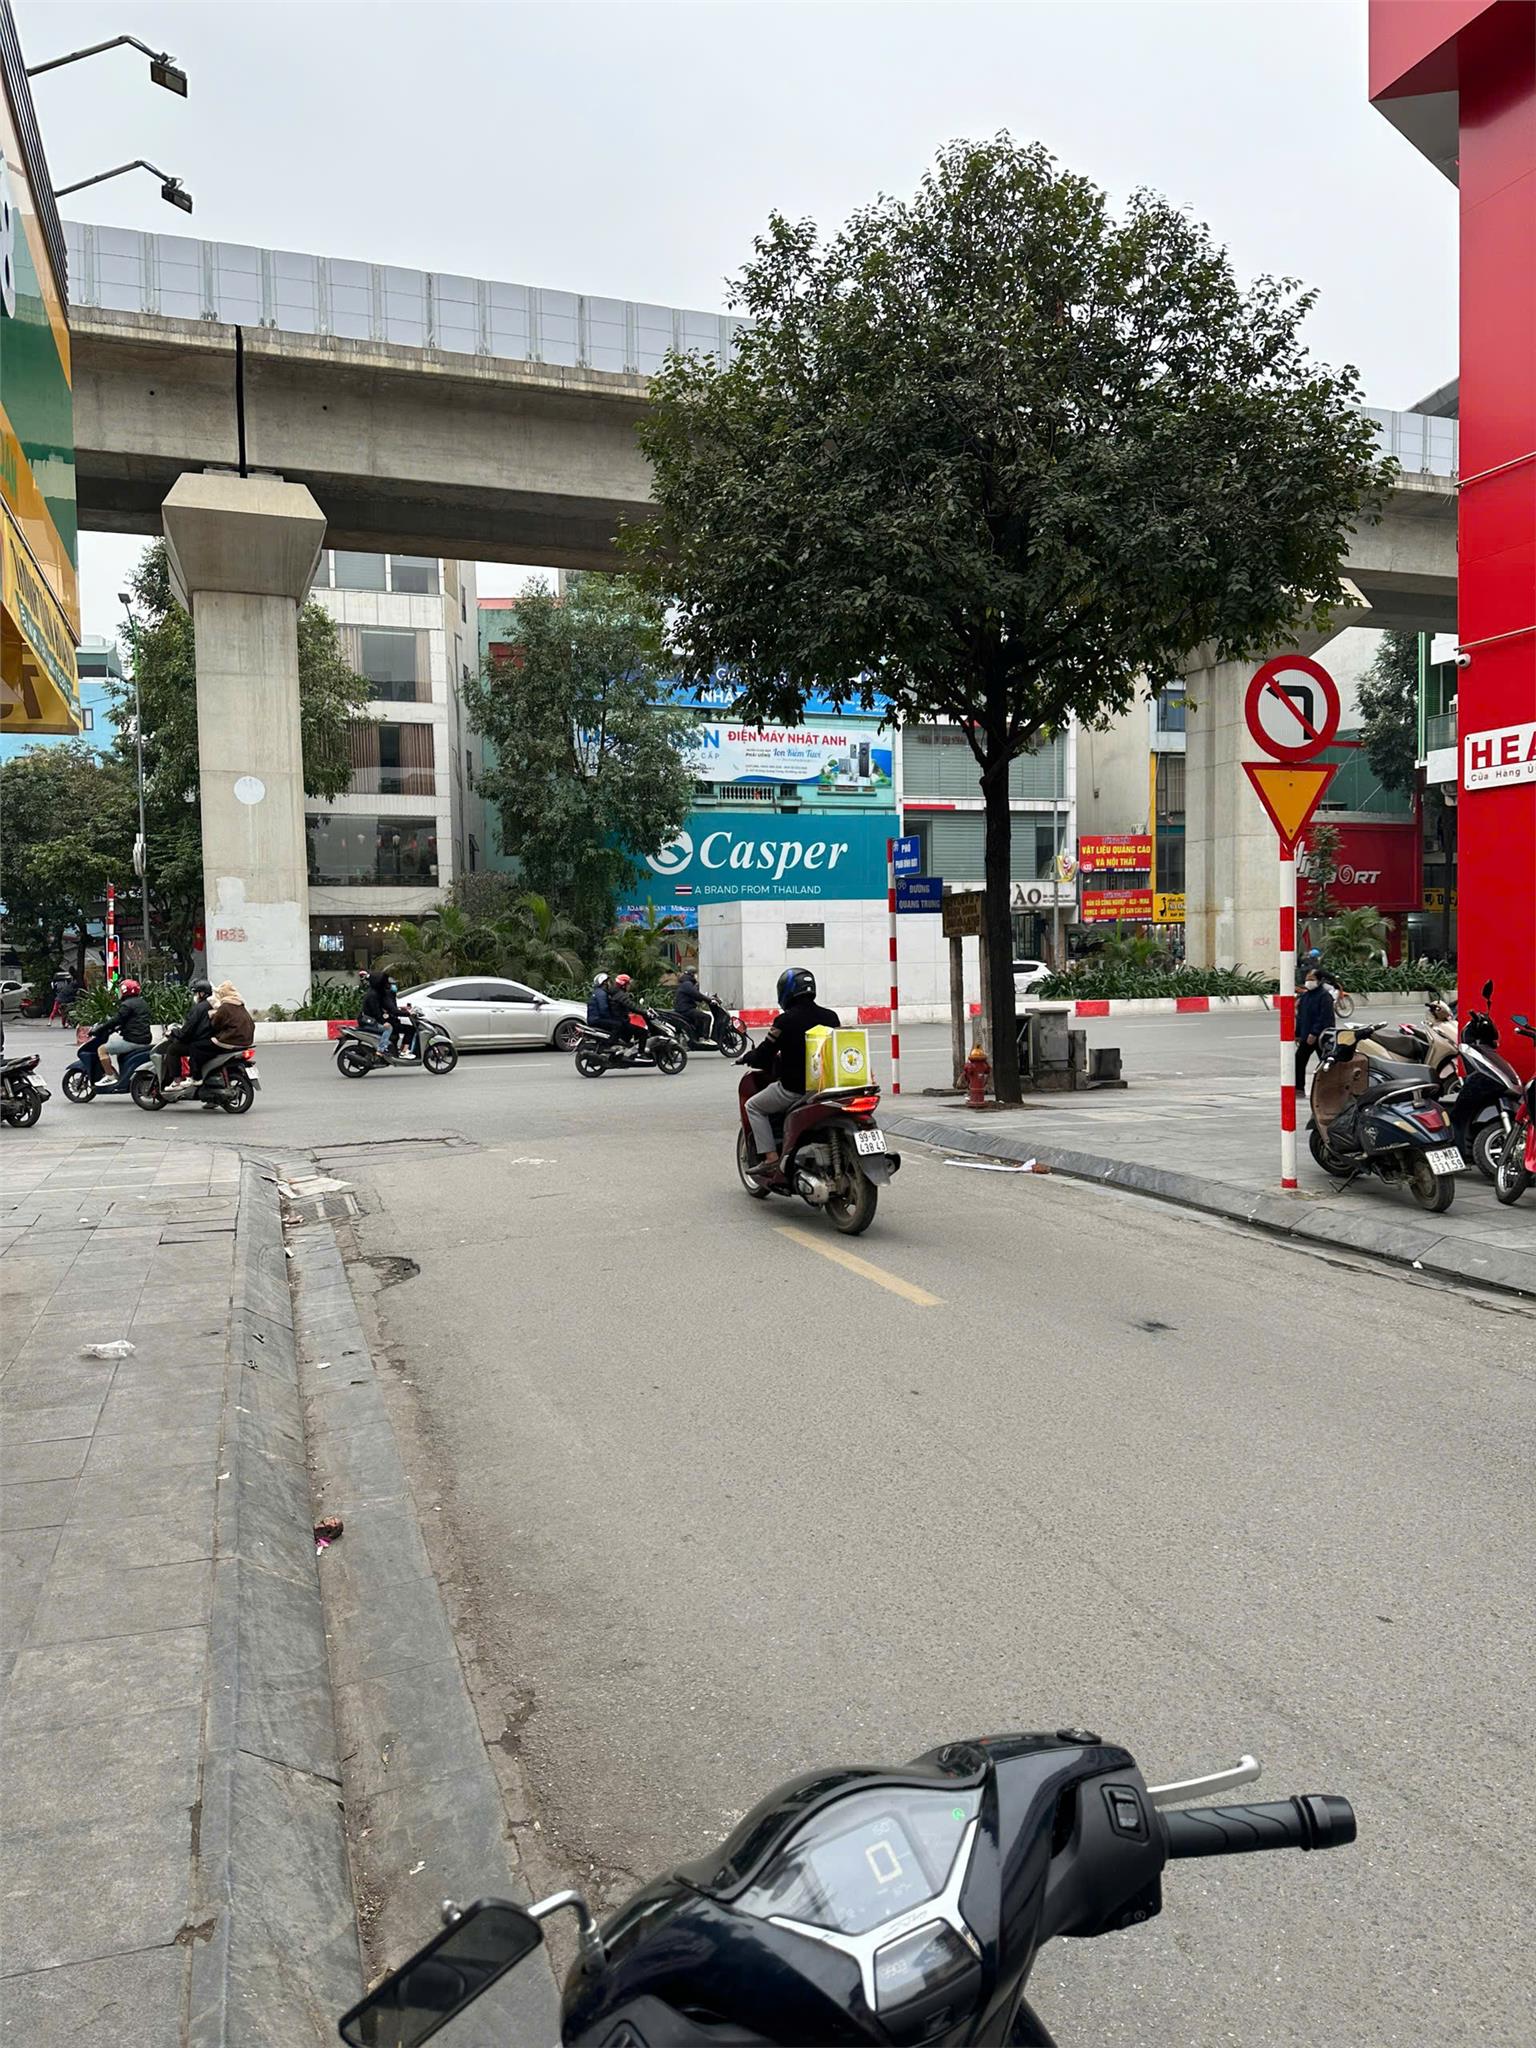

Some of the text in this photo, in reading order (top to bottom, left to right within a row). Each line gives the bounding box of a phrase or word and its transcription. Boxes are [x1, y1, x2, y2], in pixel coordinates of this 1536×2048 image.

[728, 728, 757, 745] ĐIỆN
[759, 729, 785, 744] MÁY
[788, 731, 820, 749] NHẬT
[822, 735, 847, 747] ANH
[1081, 844, 1094, 855] VẬT
[700, 831, 848, 880] Casper
[1095, 857, 1105, 867] VÀ
[694, 886, 822, 895] A BRAND FROM THAILAND
